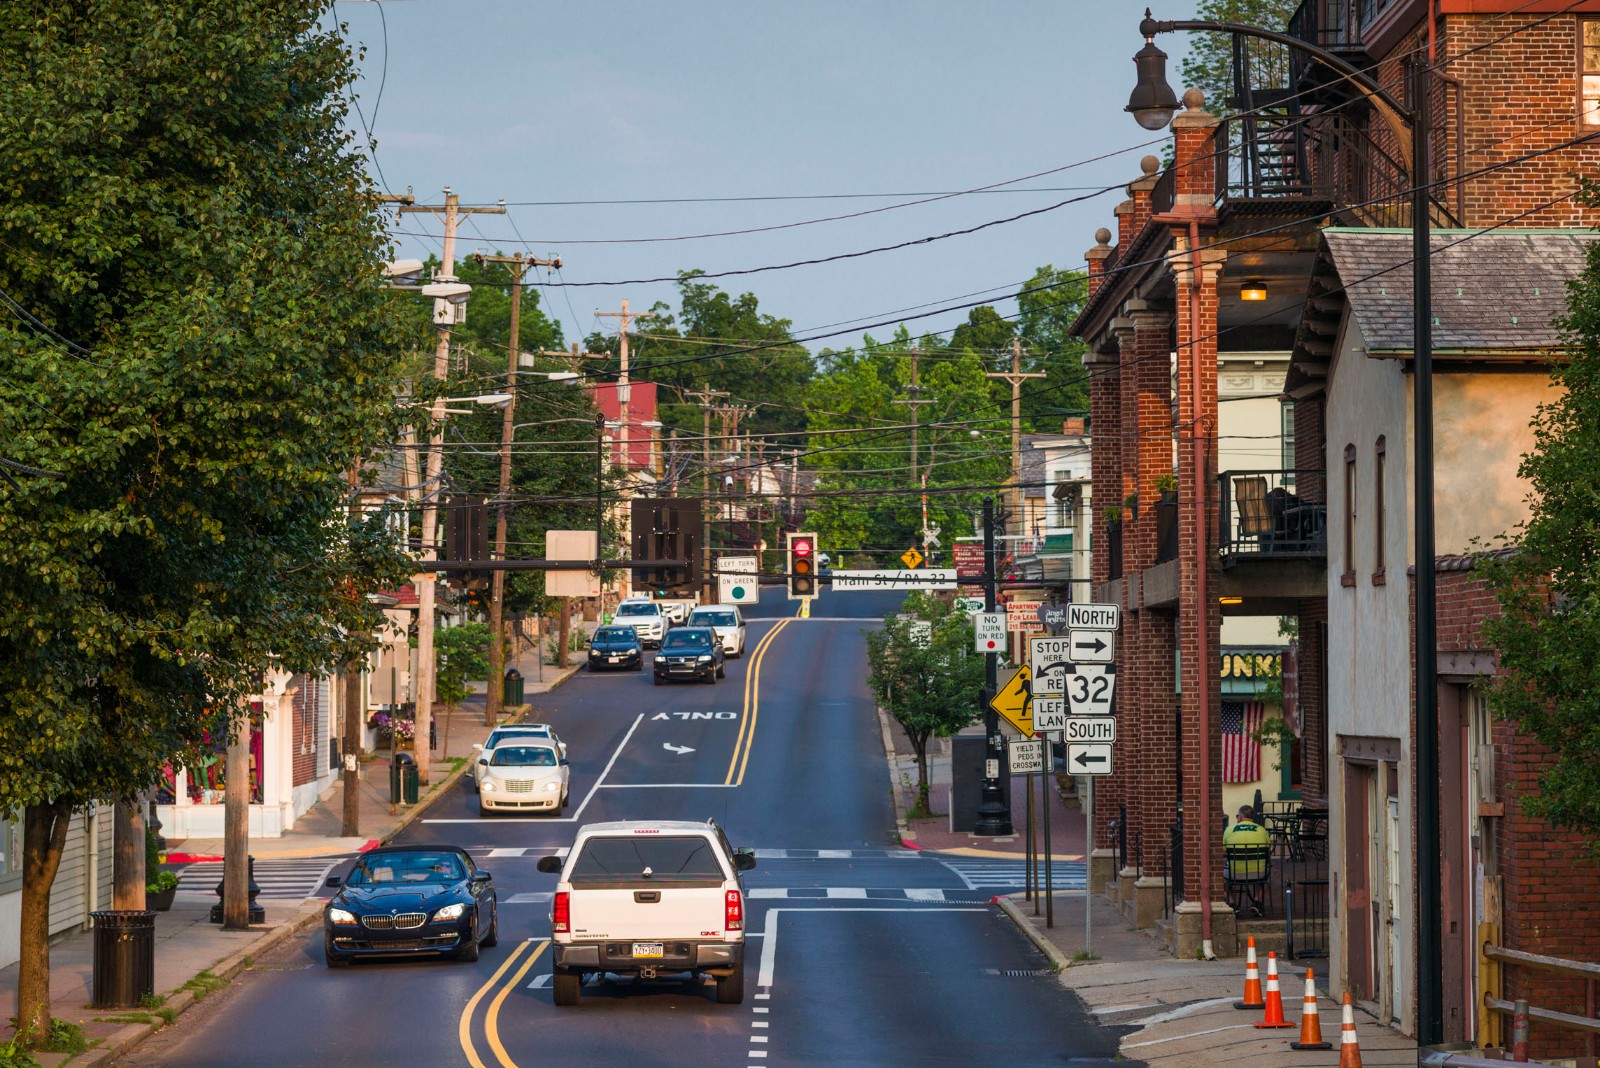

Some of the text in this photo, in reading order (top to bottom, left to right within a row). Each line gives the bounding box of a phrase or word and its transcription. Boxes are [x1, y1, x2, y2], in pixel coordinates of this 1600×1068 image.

[734, 577, 754, 585] GREEN
[838, 574, 869, 586] Main
[874, 573, 887, 586] St
[1045, 609, 1064, 618] angel
[1071, 608, 1115, 625] NORTH
[984, 616, 998, 624] NO
[990, 632, 1005, 640] RED
[1036, 642, 1070, 653] STOP
[1043, 654, 1063, 662] HERE
[1047, 679, 1063, 690] RE
[1071, 675, 1109, 704] 32
[1040, 702, 1064, 713] LEF
[651, 711, 738, 720] ONLY
[1038, 715, 1063, 726] LAN
[1069, 721, 1112, 738] SOUTH
[1015, 744, 1034, 752] YIELD
[1017, 753, 1035, 761] PEDS
